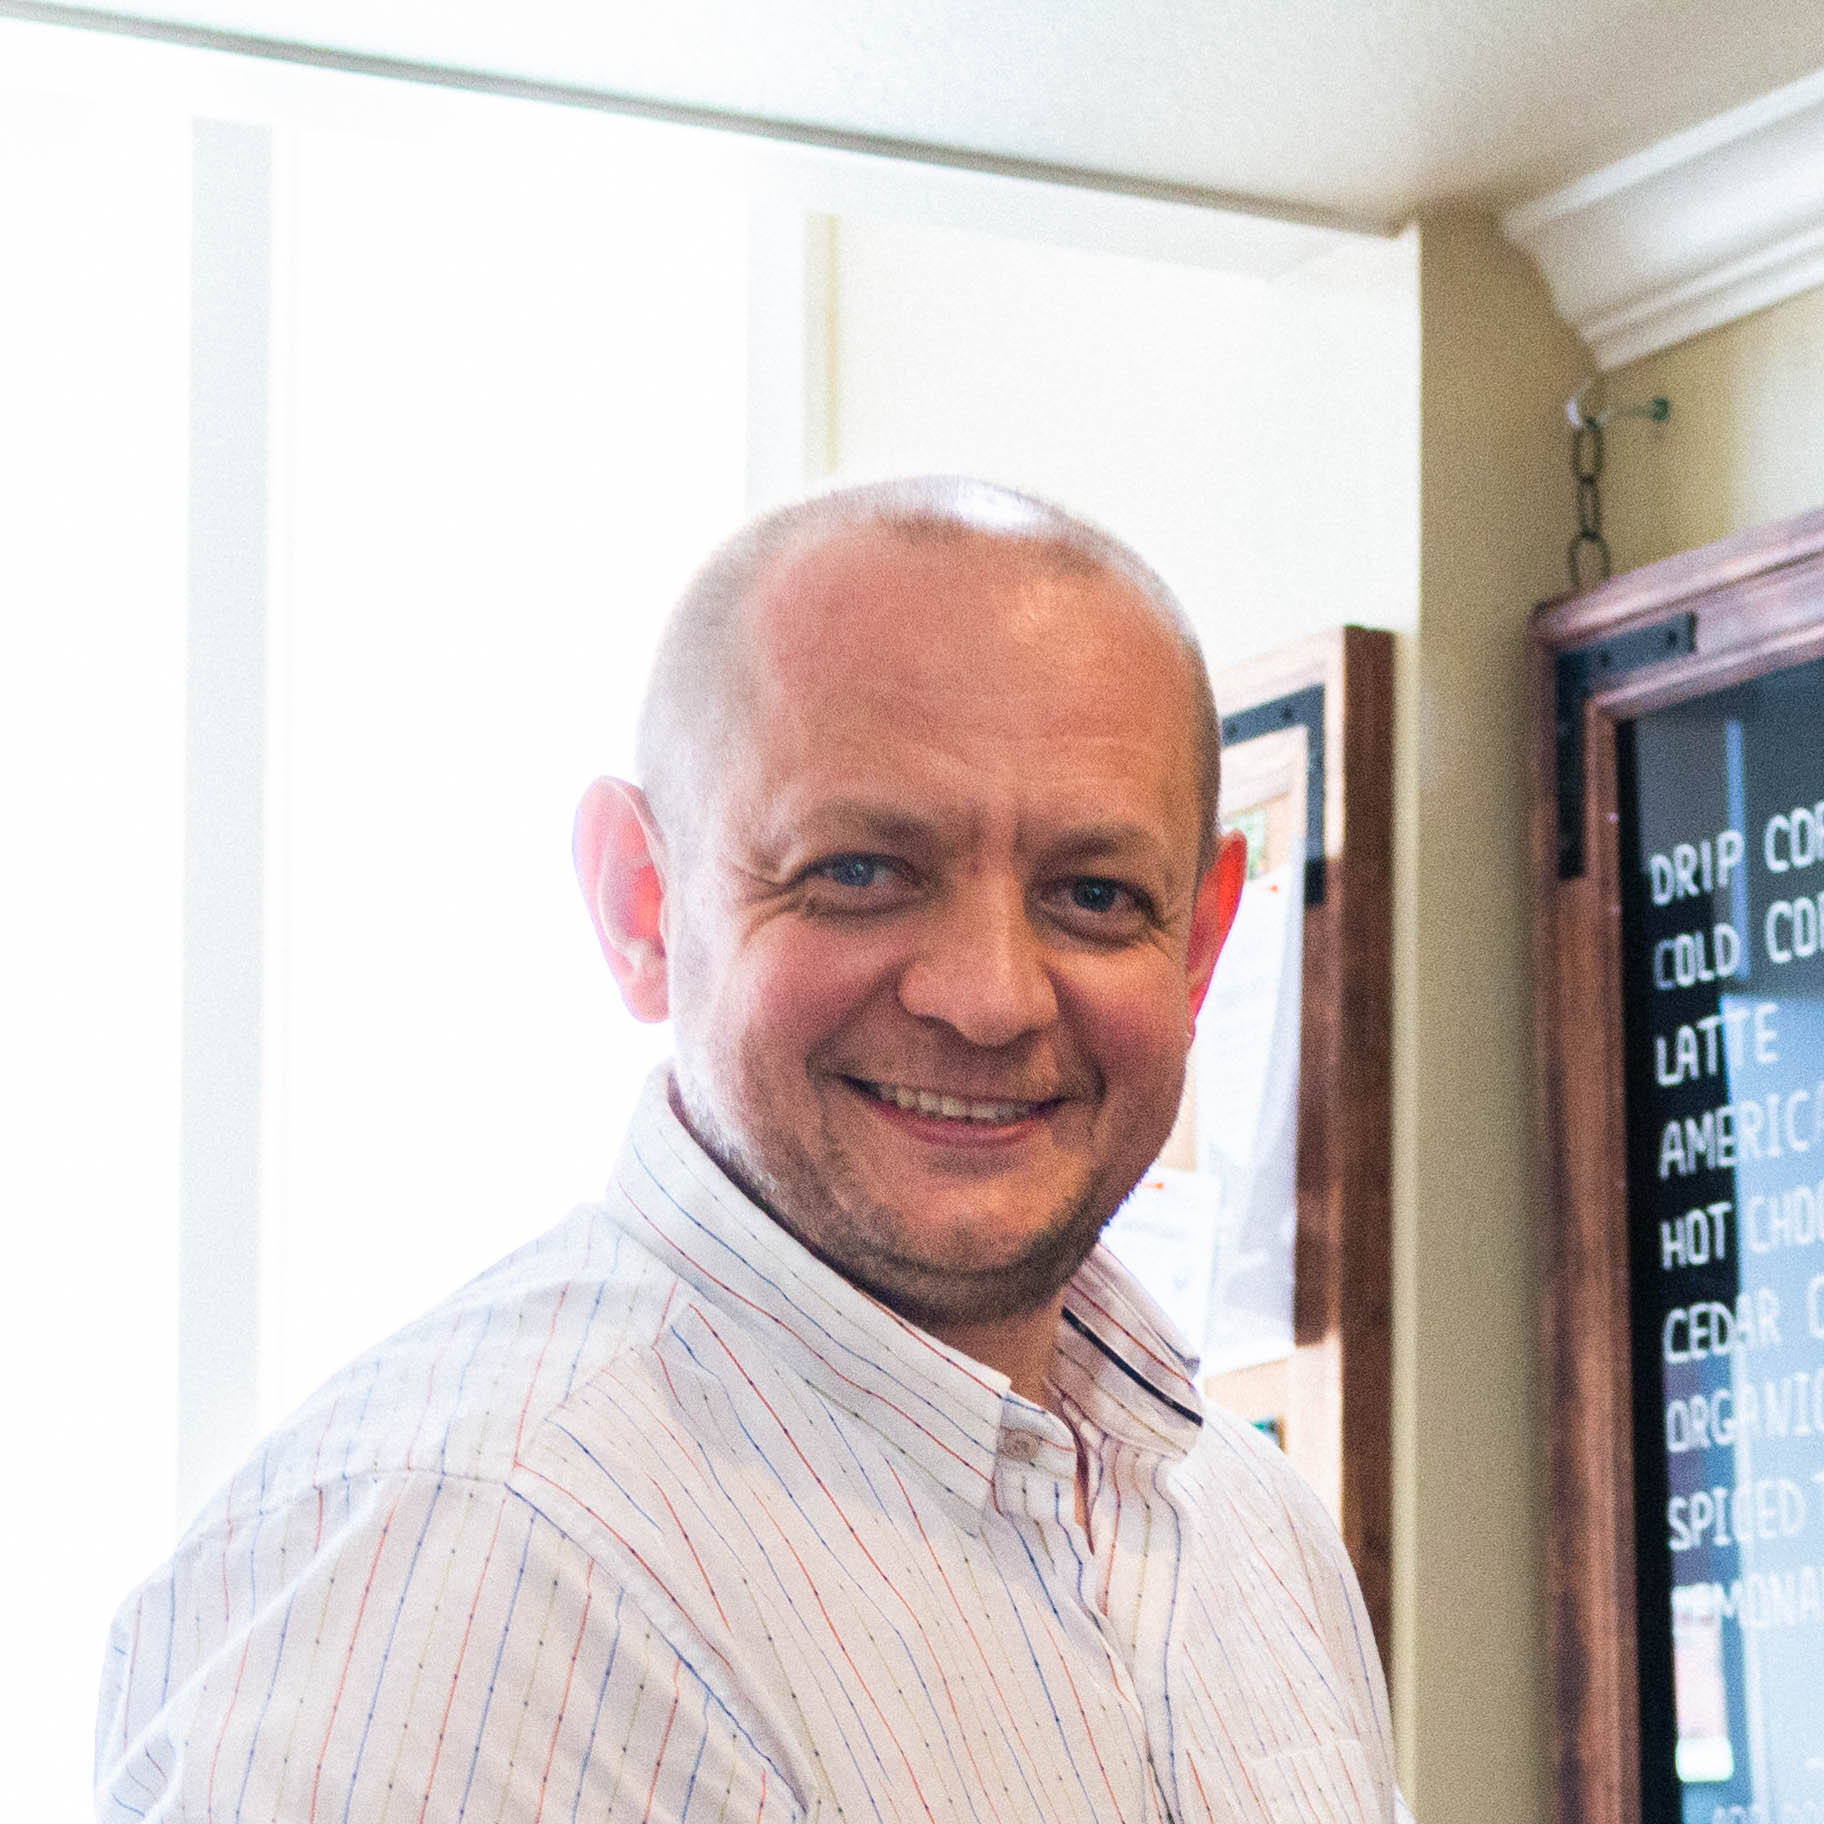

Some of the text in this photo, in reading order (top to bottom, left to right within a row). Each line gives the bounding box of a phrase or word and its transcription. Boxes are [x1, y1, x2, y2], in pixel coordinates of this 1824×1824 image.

[1651, 830, 1746, 906] DRIP
[1654, 922, 1740, 990] COLD
[1654, 1004, 1780, 1088] LATTE
[1658, 1200, 1733, 1274] HOT
[1662, 1286, 1782, 1365] CEDAR
[1667, 1475, 1807, 1552] SPICED
